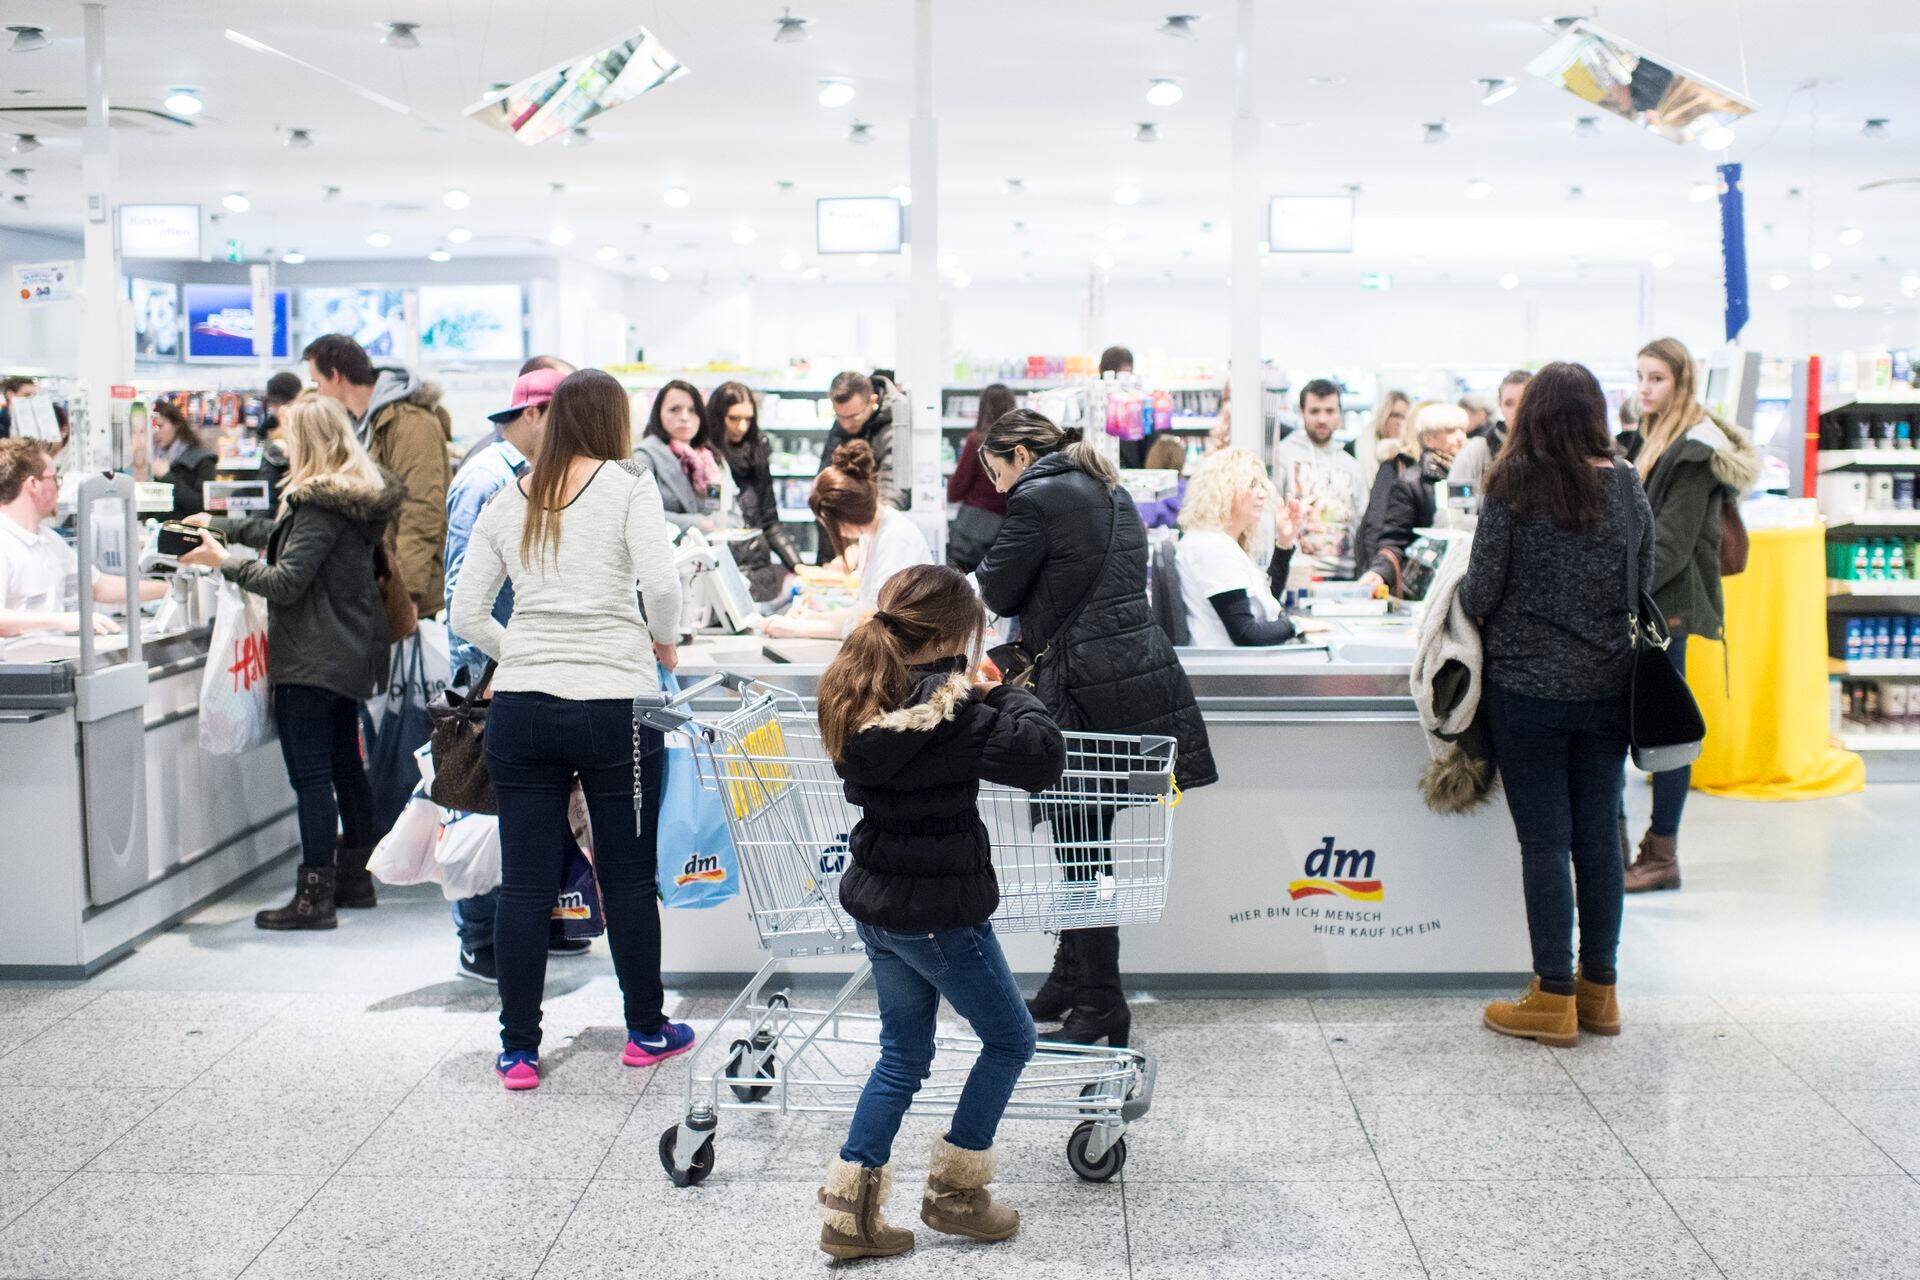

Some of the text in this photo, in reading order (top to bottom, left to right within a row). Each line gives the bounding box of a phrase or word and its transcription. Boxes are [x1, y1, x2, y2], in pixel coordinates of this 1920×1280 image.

[819, 832, 851, 874] d
[1303, 836, 1377, 879] dm
[684, 853, 718, 876] dm
[558, 893, 582, 908] m
[1229, 906, 1382, 924] HIER BIN ICH MENSCH
[1312, 919, 1442, 938] HIER KAUF ICH EIN
